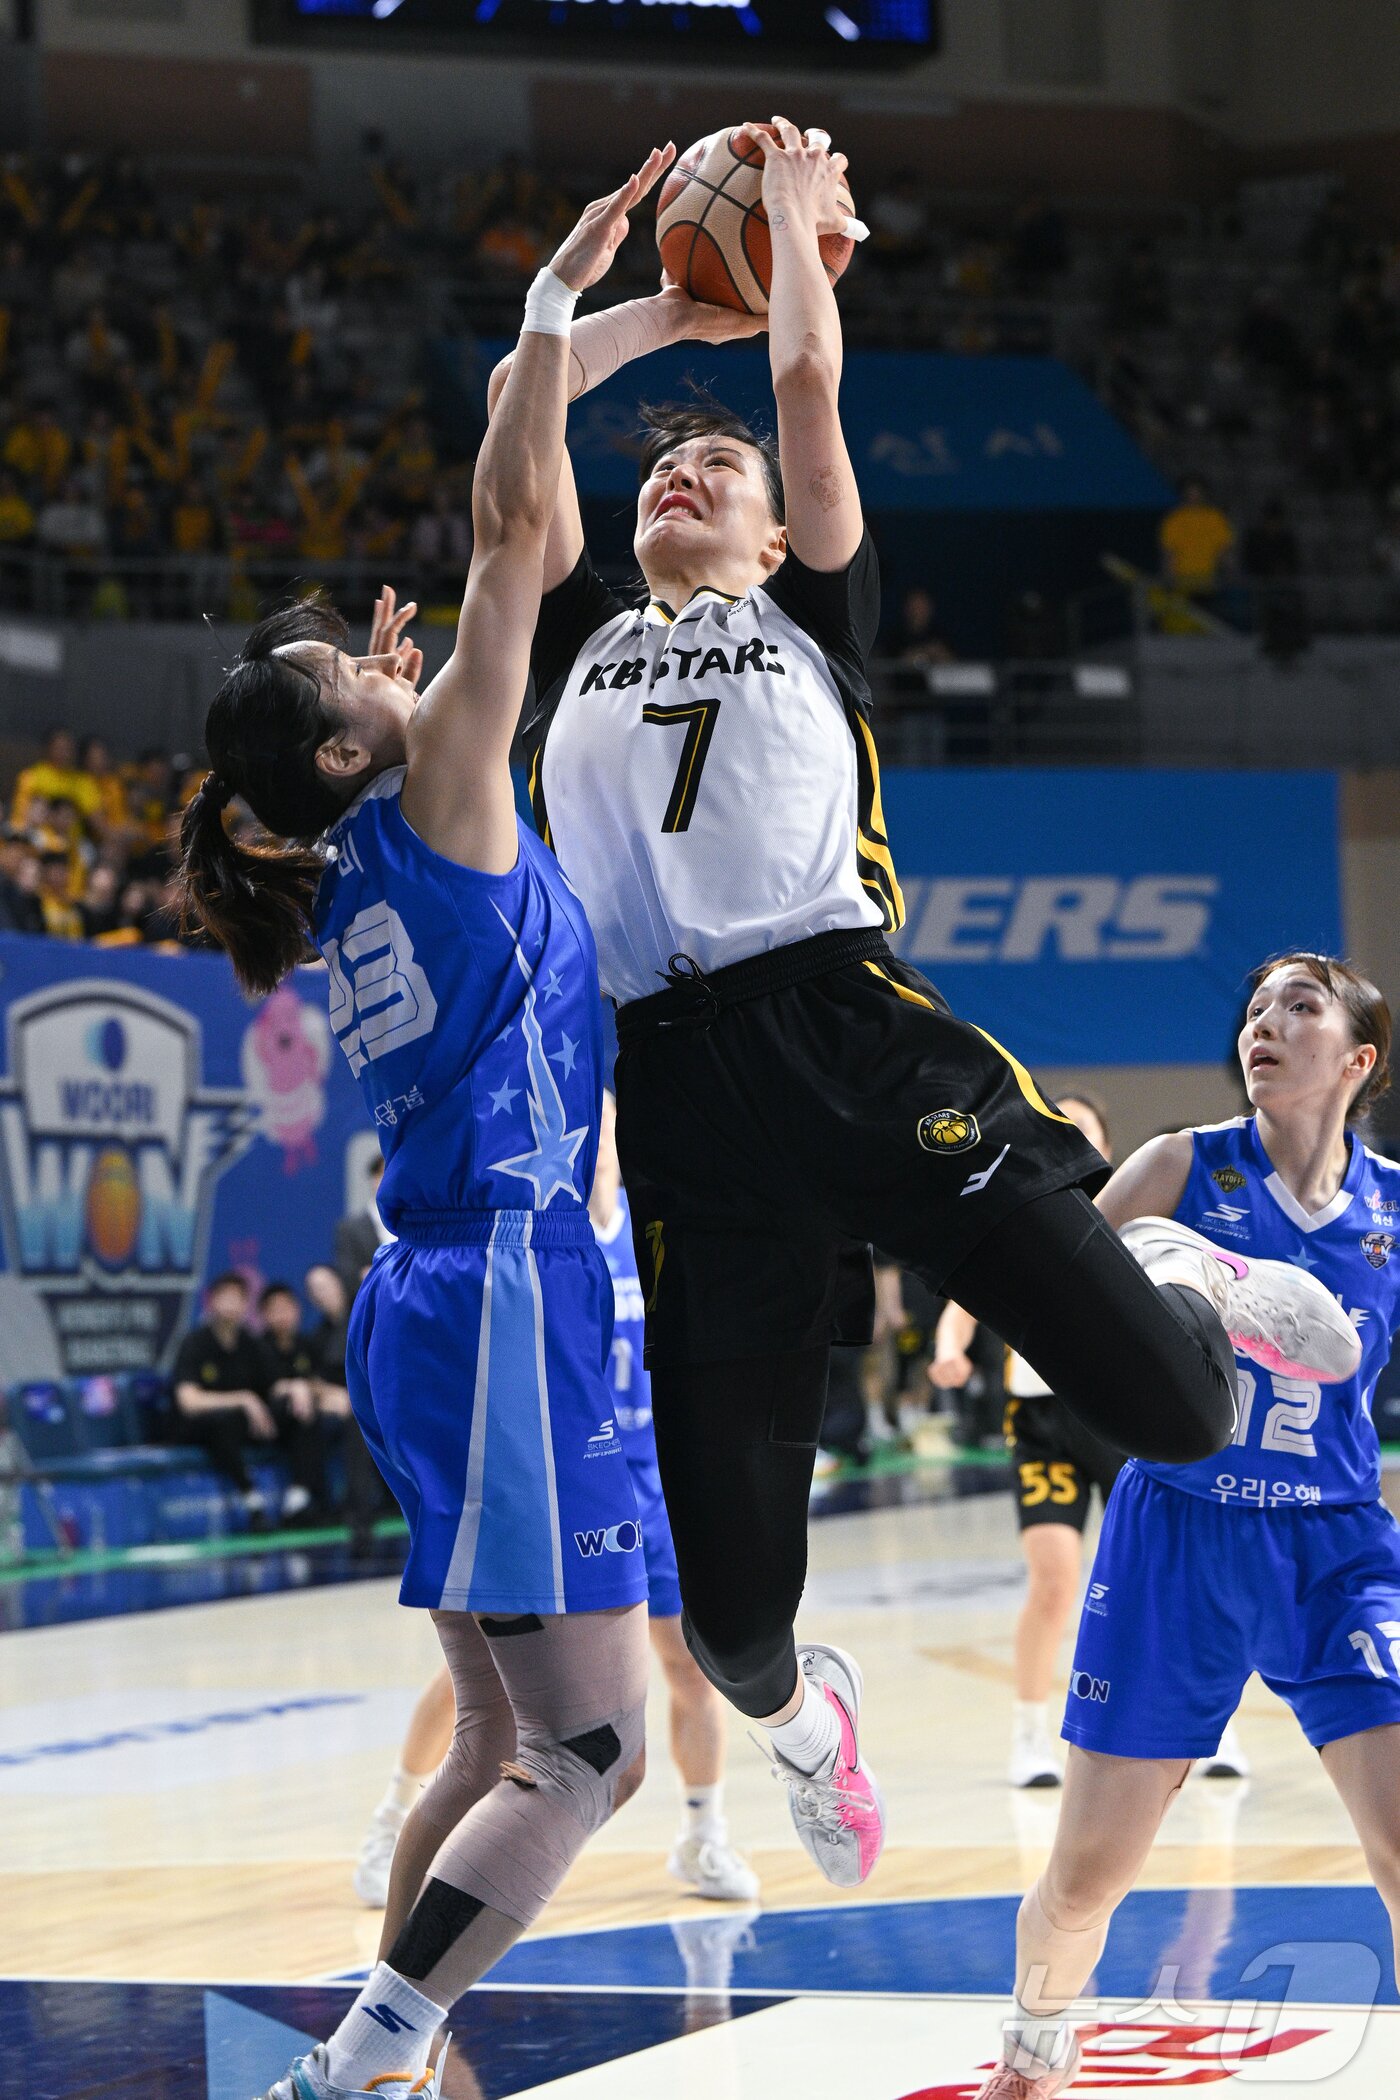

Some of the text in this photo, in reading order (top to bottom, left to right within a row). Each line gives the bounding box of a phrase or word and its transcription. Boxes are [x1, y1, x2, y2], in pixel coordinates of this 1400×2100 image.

[642, 698, 721, 833] 7
[1231, 1368, 1322, 1457] 12
[1018, 1461, 1079, 1507] 55
[1211, 1474, 1322, 1508] 우리은행
[1069, 1668, 1110, 1704] ON
